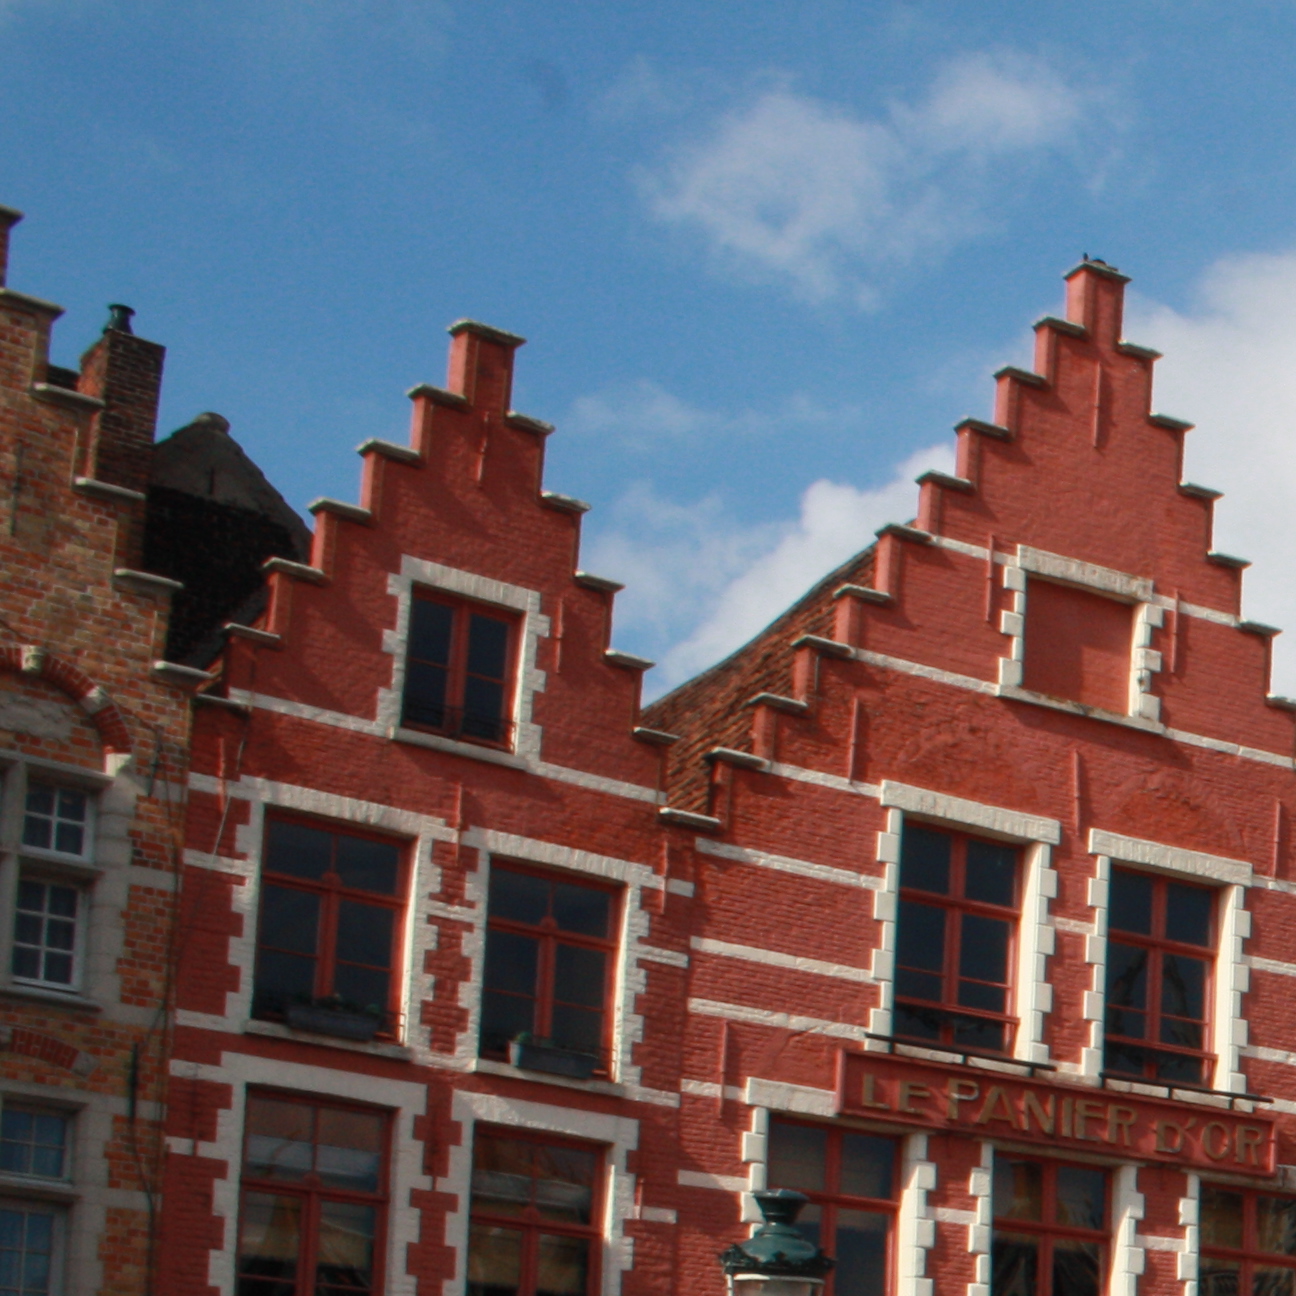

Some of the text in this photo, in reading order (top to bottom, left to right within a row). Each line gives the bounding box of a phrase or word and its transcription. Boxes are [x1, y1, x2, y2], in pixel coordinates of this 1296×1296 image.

[862, 1072, 1266, 1167] LE PANIER D'OR
